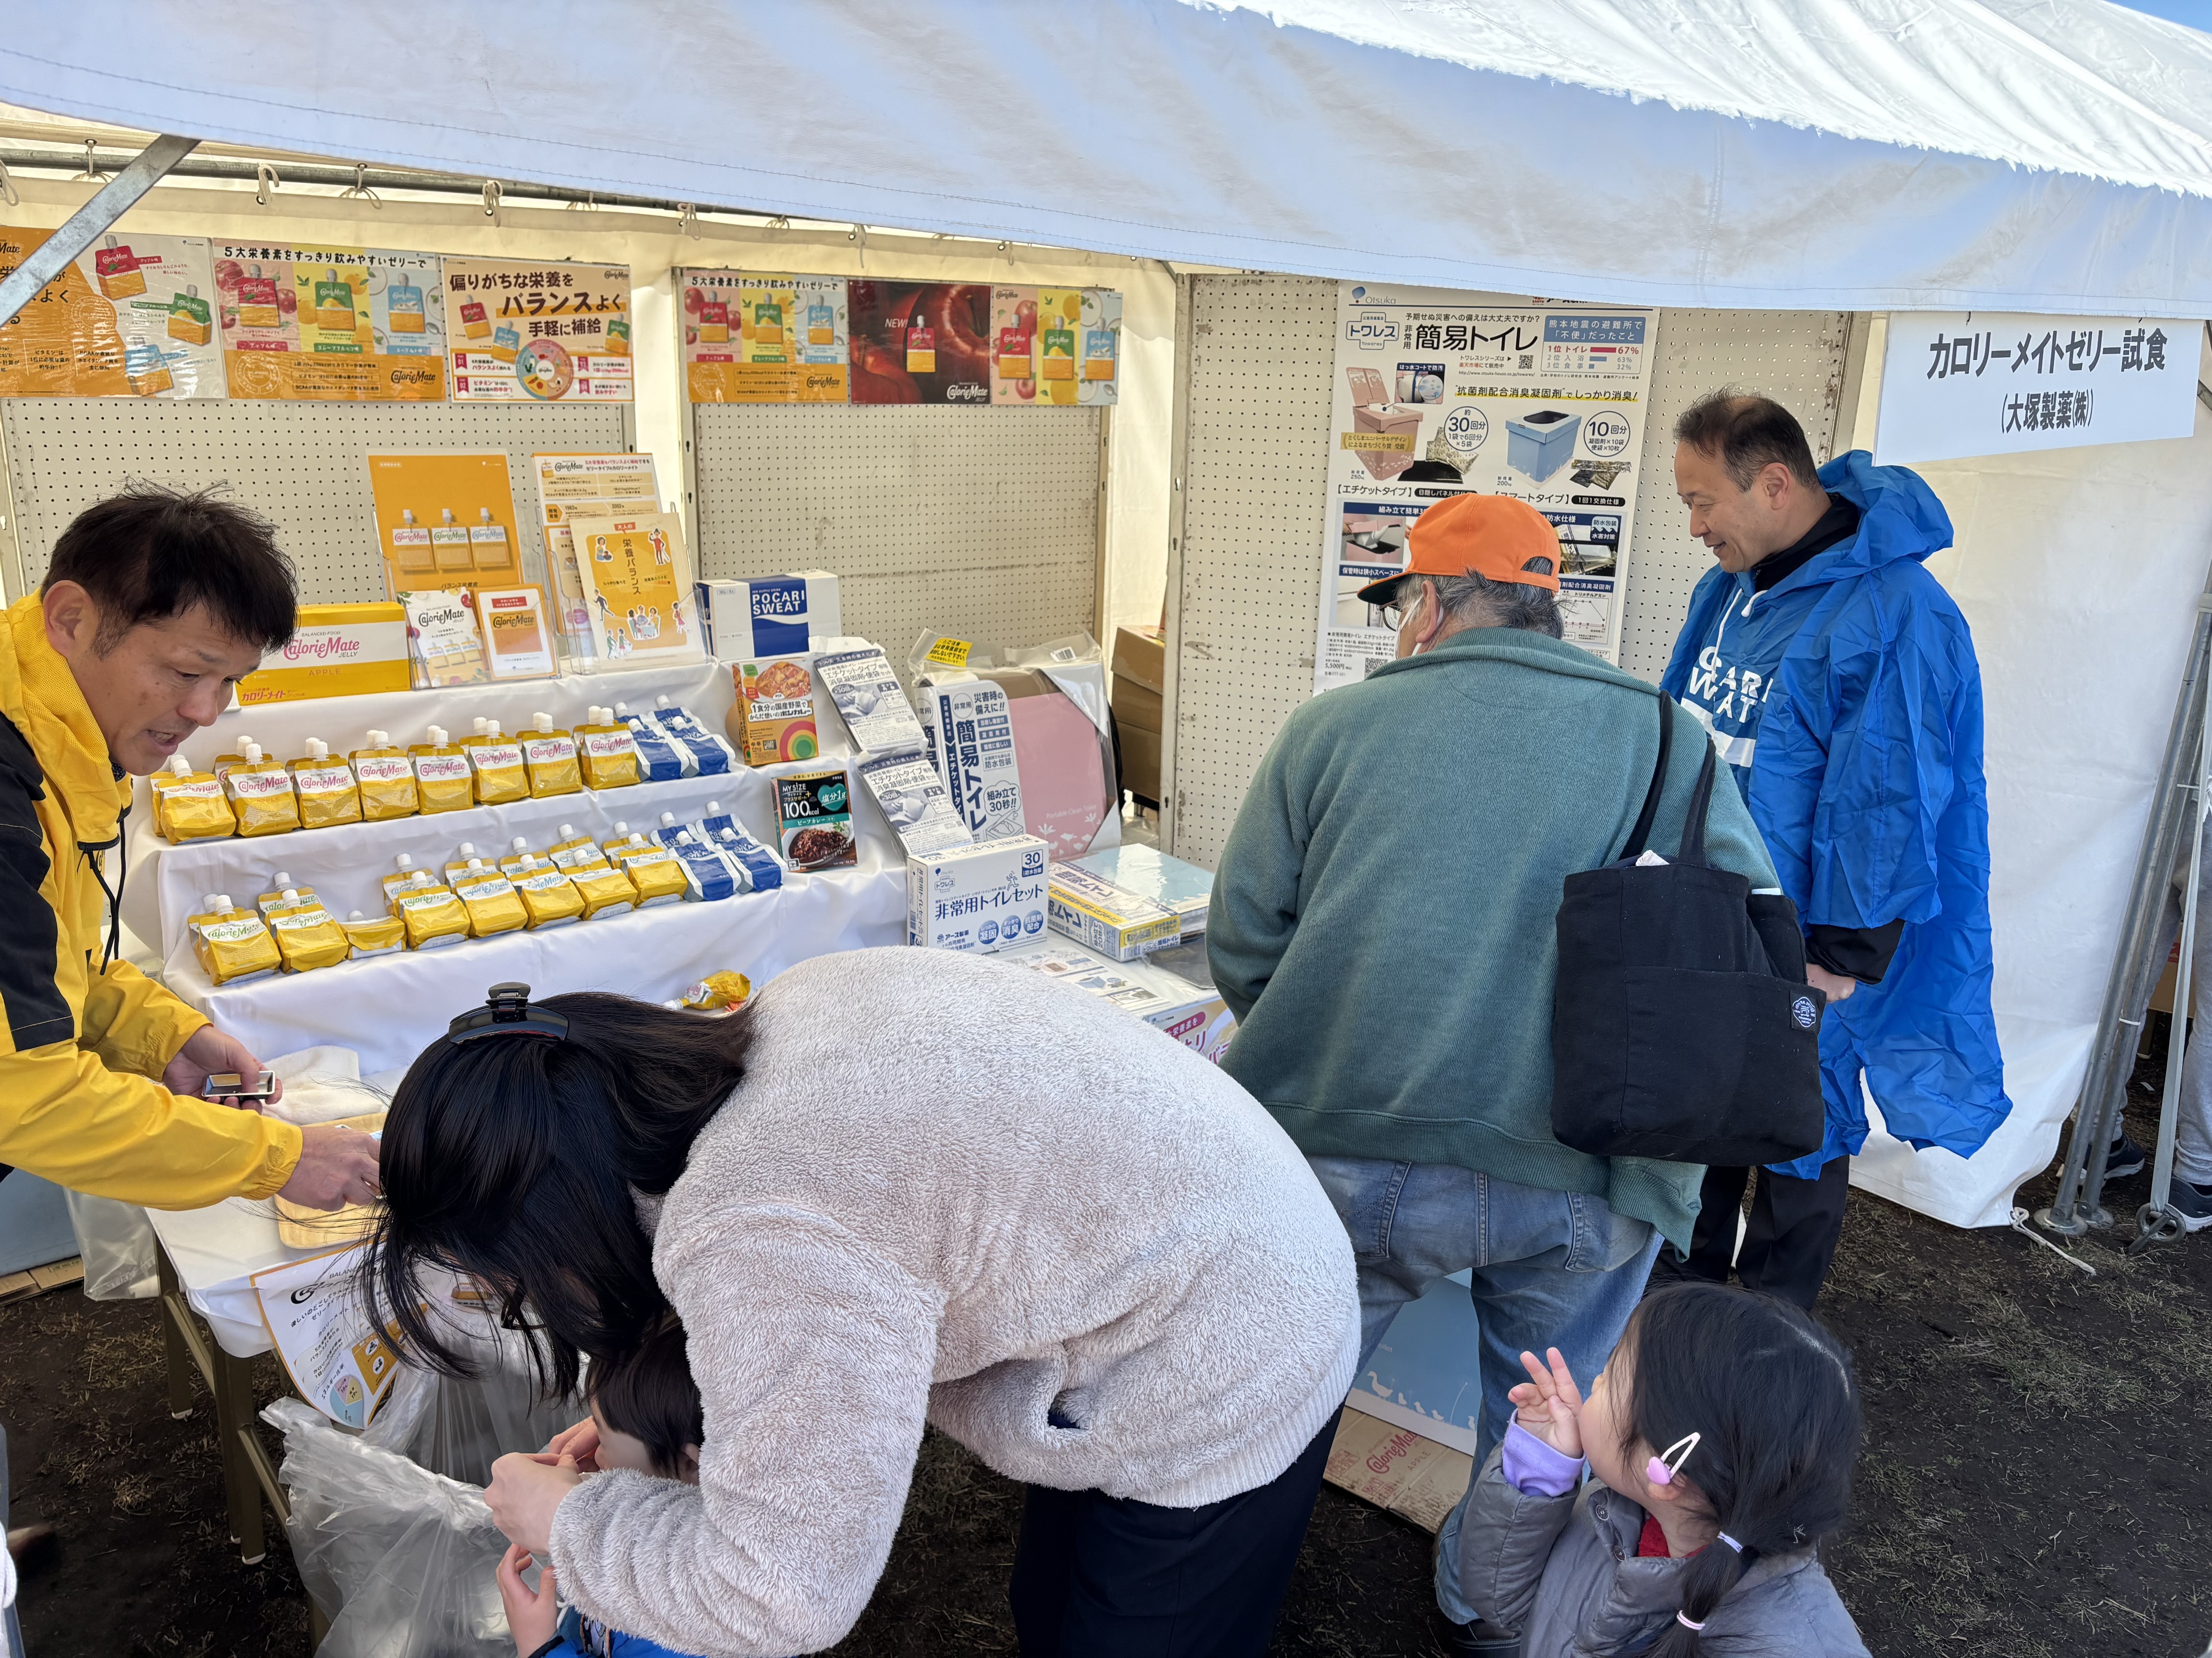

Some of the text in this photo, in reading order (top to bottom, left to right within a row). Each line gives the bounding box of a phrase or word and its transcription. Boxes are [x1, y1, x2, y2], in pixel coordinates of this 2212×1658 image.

[103, 253, 128, 264] CalorieMate
[225, 246, 426, 268] 5大栄養素をすっきり飲みやすいゼリーで
[450, 271, 573, 291] 偏りがちな栄養を
[692, 277, 838, 290] 5大栄養素をすっきり飲みやすいゼリーで
[502, 291, 621, 316] バランスよく
[1365, 296, 1396, 304] Otsuka
[884, 318, 908, 328] NEW!
[1405, 313, 1540, 323] 予期せぬ災害への備えは大丈夫ですか?
[1549, 319, 1643, 329] 熊本地震の避難所で
[528, 318, 602, 337] 手軽に補給
[1350, 325, 1396, 337] トワレス
[1403, 324, 1413, 349] 非常用
[1415, 324, 1538, 352] 簡易トイレ
[1554, 330, 1635, 340] 「不便」だったこと
[1548, 345, 1639, 355] 1位 トイレ 67%
[1927, 327, 2168, 380] カロリーメイトゼリー試食
[391, 370, 436, 384] CalorieMate
[806, 376, 840, 388] CalorieMate
[946, 384, 988, 400] CalorieMate
[2001, 388, 2094, 434] (大塚製薬(株))
[1448, 417, 1486, 433] 30回分
[1588, 421, 1627, 436] 10回分
[1448, 433, 1483, 441] 1袋で6回分
[555, 462, 583, 472] CalorieMate
[1338, 484, 1411, 497] 【エチケットタイプ】
[1578, 497, 1619, 505] 1回1交換仕様
[394, 531, 428, 542] CalorieMate
[433, 531, 466, 541] CalorieMate
[472, 530, 504, 539] CalorieMate
[622, 538, 641, 595] 栄養バランス
[1560, 581, 1611, 591] 剤配合消臭凝固剤
[752, 589, 805, 605] POCARI
[752, 601, 801, 615] SWEAT
[418, 609, 465, 627] CalorieMate
[493, 614, 534, 629] CalorieMate
[283, 636, 360, 661] CalorieMate
[308, 668, 341, 676] APPLE
[825, 663, 878, 679] エチケットタイプ
[241, 690, 286, 702] カロリーメイト
[974, 691, 1003, 703] 災害時の
[752, 701, 806, 713] 1食分の国産野菜で
[954, 701, 972, 710] 非常用
[975, 702, 1005, 715] 備えに!!
[530, 742, 573, 759] CalorieMate
[590, 737, 632, 753] CalorieMate
[474, 750, 519, 765] CalorieMate
[985, 758, 1012, 769] 防水包装
[360, 764, 407, 778] CalorieMate
[419, 761, 466, 776] CalorieMate
[300, 775, 348, 789] CalorieMate
[871, 767, 923, 785] エチケットタイプ
[956, 719, 987, 832] 簡易トイレ
[238, 776, 288, 793] CalorieMate
[782, 784, 792, 792] MY
[822, 790, 846, 802] 塩分1g
[987, 786, 1017, 800] 組み立て
[783, 801, 819, 819] 100kcal
[989, 797, 1017, 812] 30秒!!
[797, 818, 825, 826] ビーフカレー
[1024, 852, 1040, 865] 30
[1024, 868, 1042, 876] 防水包装
[935, 883, 1043, 921] 非常用トイレセット
[1024, 914, 1042, 924] 抗菌剤
[1002, 925, 1019, 936] 消臭
[1026, 922, 1040, 932] 配合
[945, 929, 969, 940] アース製薬
[980, 929, 997, 941] 凝固
[1377, 1342, 1394, 1353] oilet
[321, 1363, 344, 1400] エネルギー比率
[1408, 1450, 1431, 1471] APPLE
